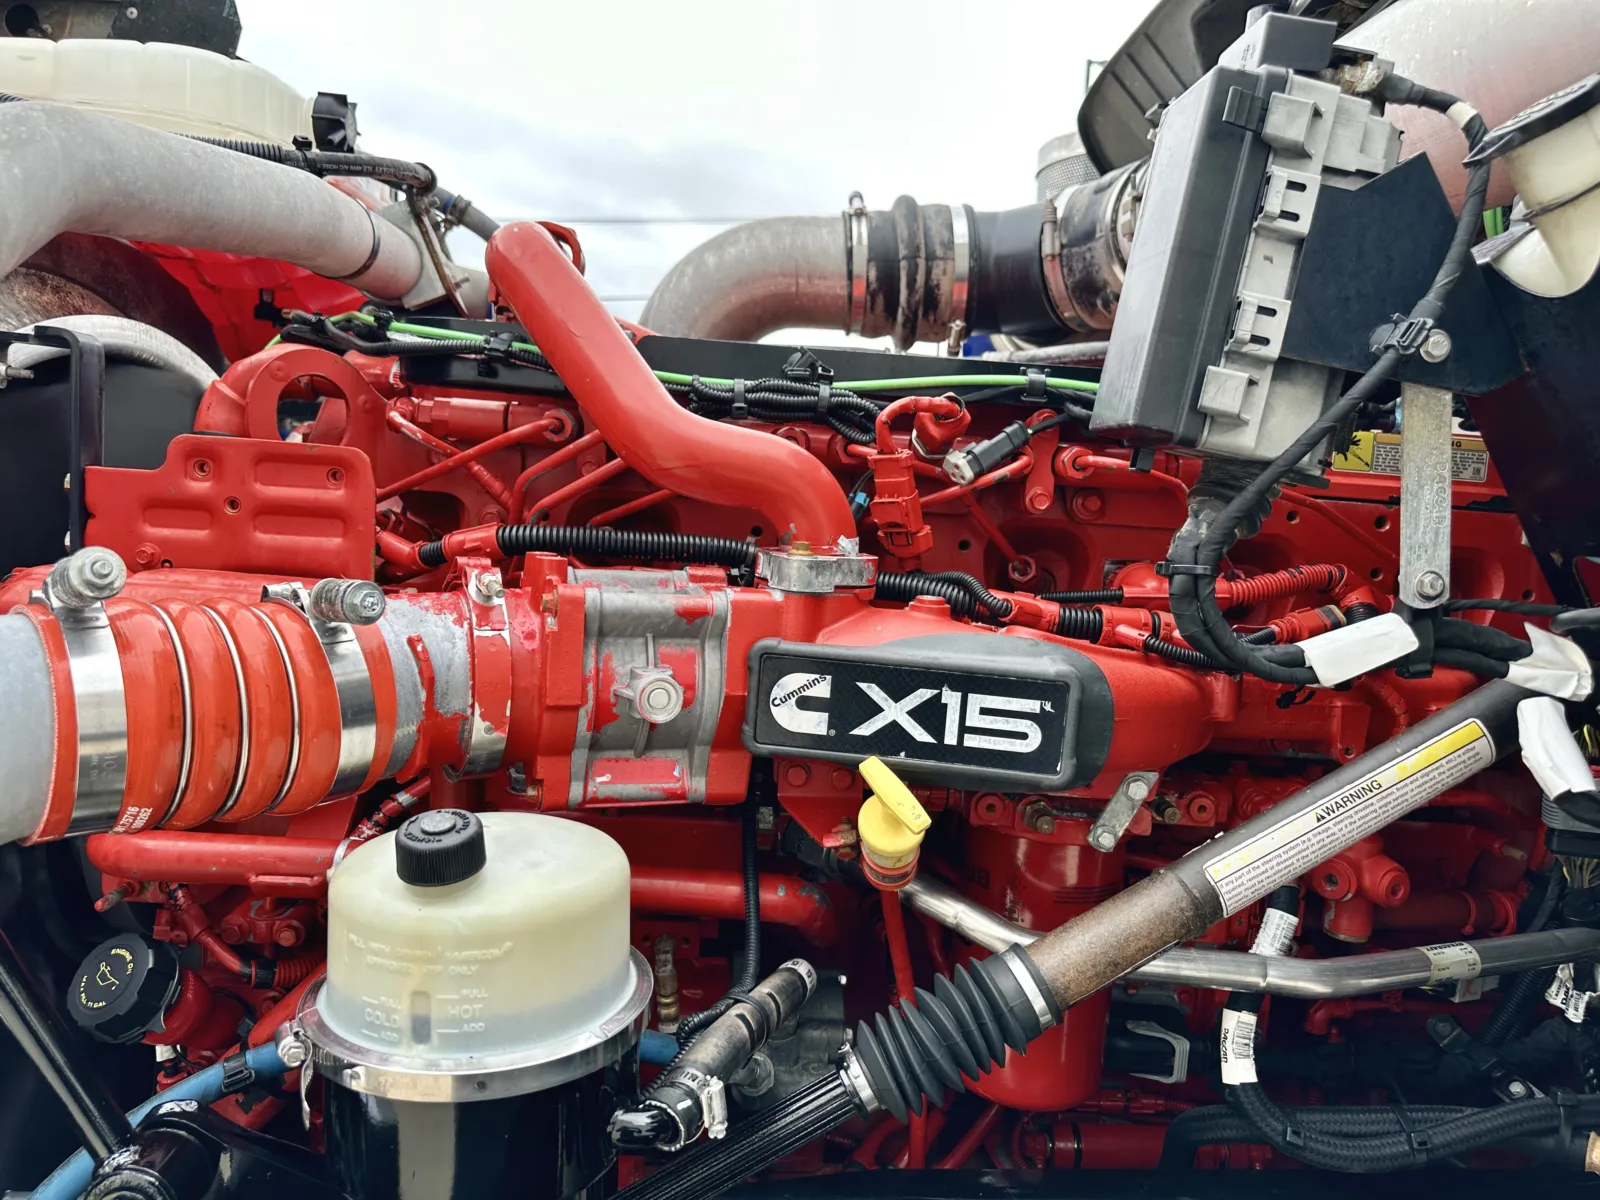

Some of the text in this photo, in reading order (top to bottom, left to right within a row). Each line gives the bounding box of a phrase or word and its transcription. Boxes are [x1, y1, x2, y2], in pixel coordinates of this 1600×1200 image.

[321, 162, 338, 170] HOSE
[770, 673, 827, 708] Cummins
[849, 682, 1042, 753] X15
[1321, 778, 1382, 818] WARNING
[1222, 880, 1246, 897] repaired,
[1245, 867, 1268, 883] removed
[1274, 844, 1310, 867] disassembled
[1314, 837, 1325, 846] any
[1347, 818, 1357, 826] the
[1356, 807, 1378, 823] steering
[1377, 799, 1393, 811] angle
[1391, 790, 1409, 802] sensor
[1436, 769, 1446, 777] the
[1445, 757, 1467, 773] steering
[1465, 750, 1481, 762] angle
[1224, 879, 1235, 888] any
[1233, 872, 1246, 883] part
[1250, 863, 1260, 871] the
[1259, 851, 1283, 868] steering
[1280, 841, 1301, 856] system
[1331, 812, 1354, 828] steering
[1460, 744, 1476, 756] either
[1225, 890, 1243, 902] sensor
[1242, 881, 1257, 892] must
[1255, 877, 1264, 885] be
[1299, 852, 1309, 860] the
[1308, 834, 1341, 855] recalibration
[1345, 826, 1355, 835] not
[1354, 812, 1382, 831] performed
[111, 948, 134, 975] ENGINE OIL
[448, 964, 479, 976] ONLY
[80, 992, 88, 1005] FILL
[364, 1008, 401, 1028] COLD
[449, 1004, 483, 1019] HOT
[380, 1029, 400, 1042] ADD
[462, 1022, 485, 1032] ADD
